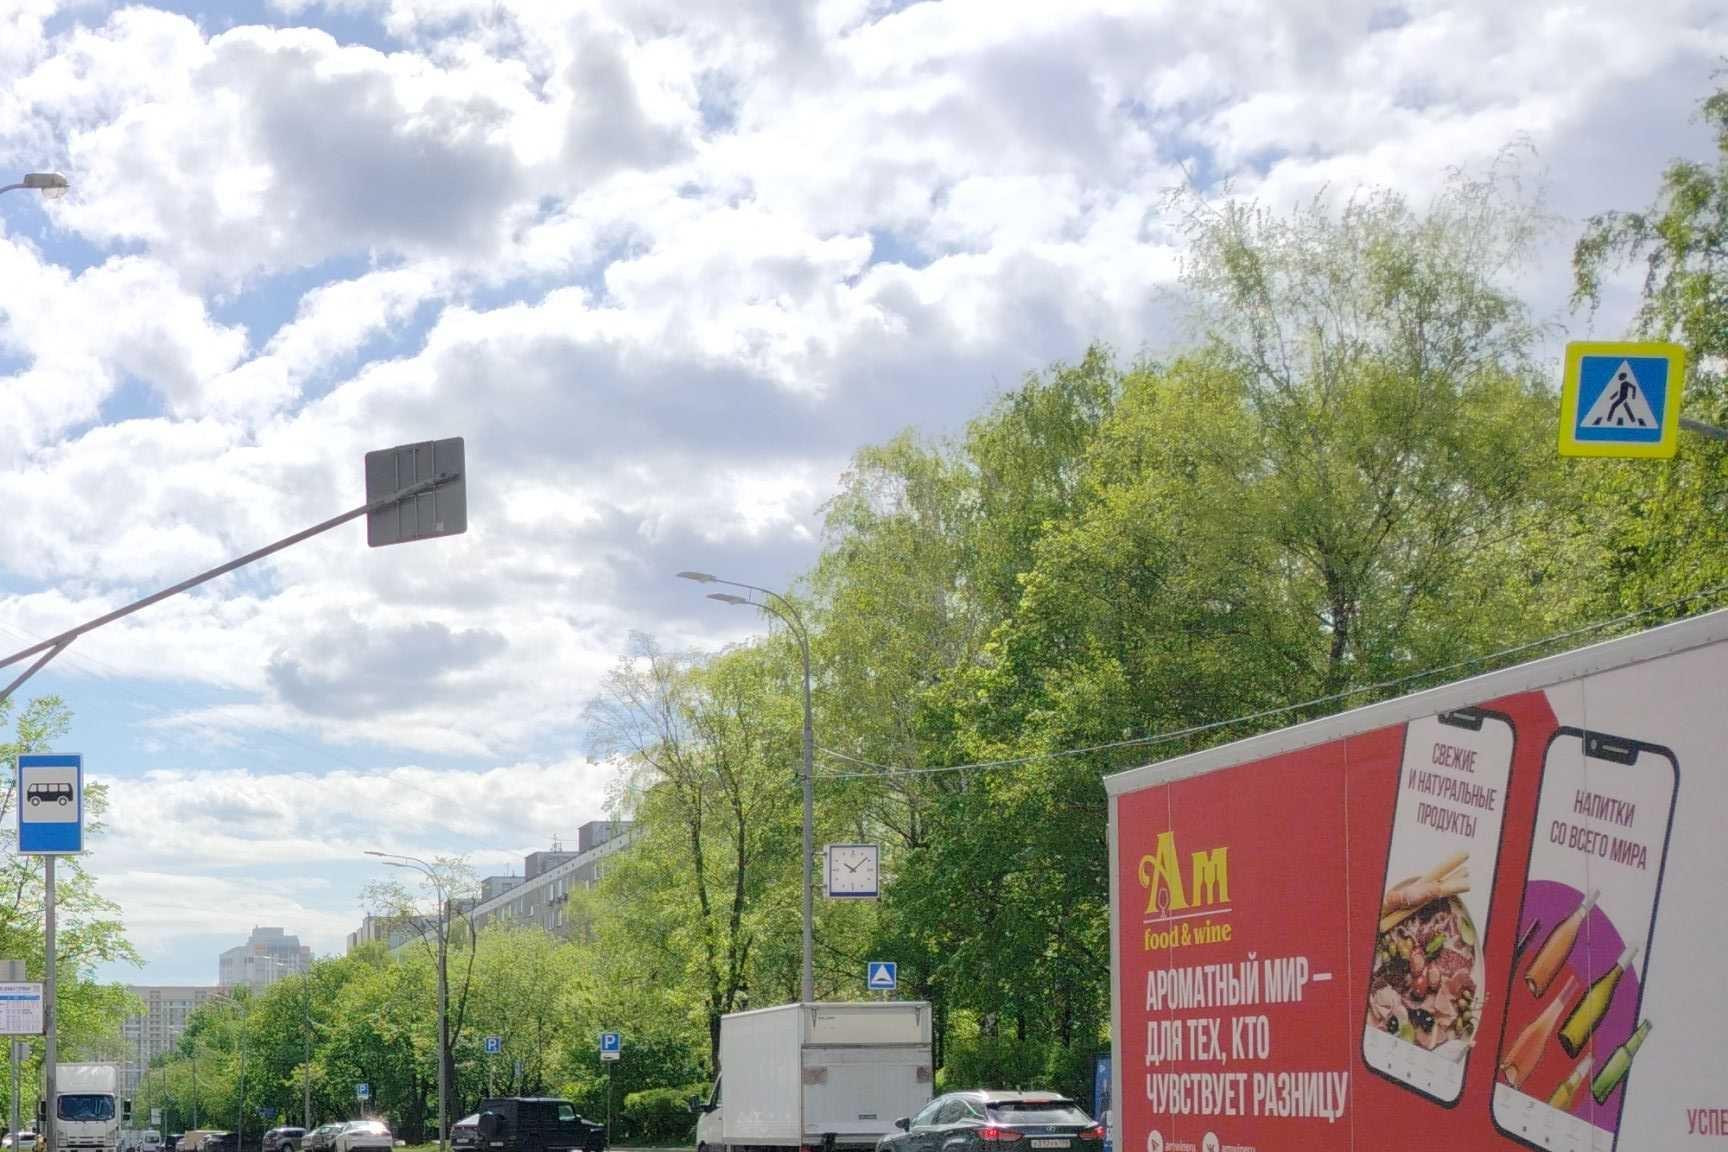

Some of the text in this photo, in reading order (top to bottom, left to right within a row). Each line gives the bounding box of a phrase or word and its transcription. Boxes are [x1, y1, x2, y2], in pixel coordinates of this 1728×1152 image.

[1432, 742, 1478, 773] СВЕЖИЕ
[1408, 768, 1497, 811] И НАТУРАЛЬНЫЕ
[1574, 789, 1636, 828] НАПИТКИ
[1416, 802, 1478, 838] ПРОДУКТЫ
[1550, 820, 1648, 870] СО ВСЕГО МИРА
[1144, 920, 1232, 951] food & wine
[1146, 951, 1260, 1011] АРОМАТНЫЙ
[1145, 1015, 1270, 1067] ДЛЯ ТЕХ, КТО
[1146, 1071, 1349, 1124] ЧУВСТВУЕТ РАЗНИЦУ
